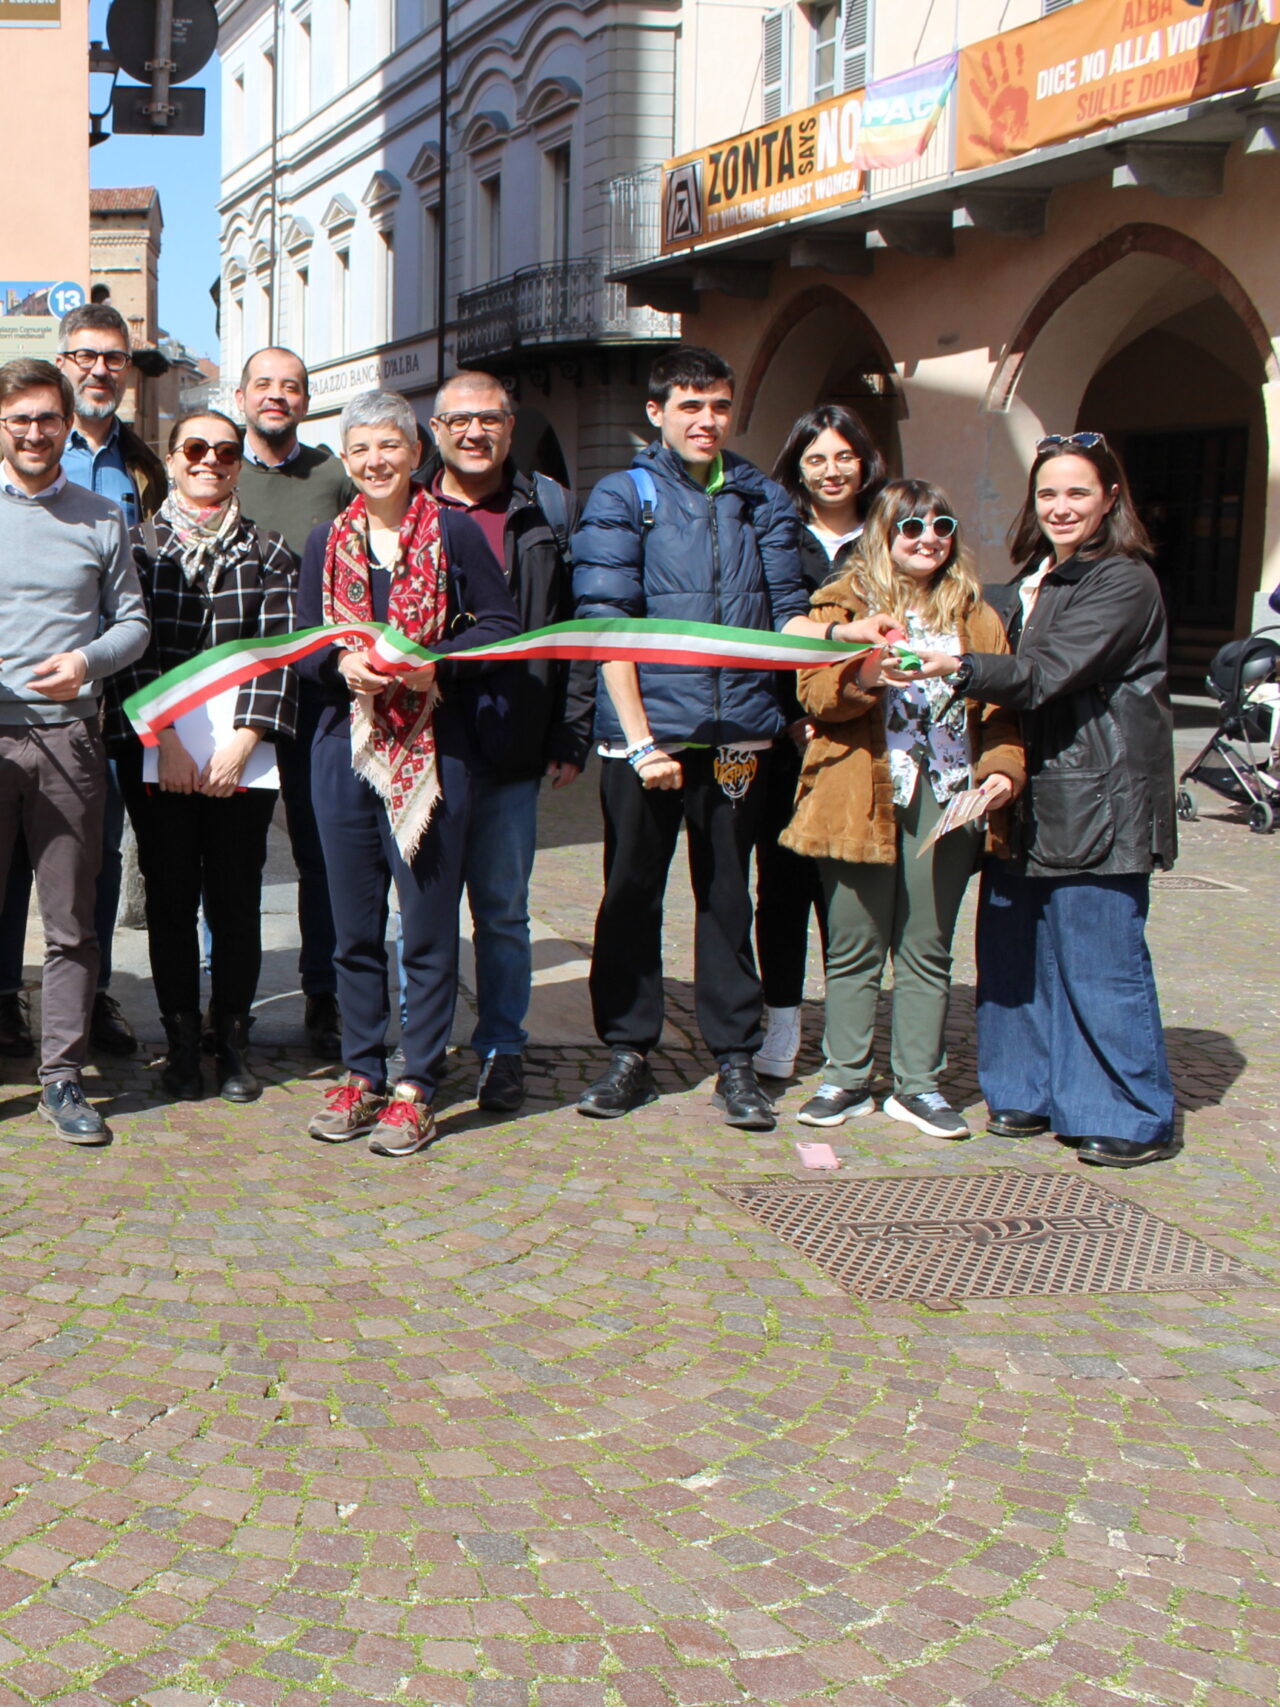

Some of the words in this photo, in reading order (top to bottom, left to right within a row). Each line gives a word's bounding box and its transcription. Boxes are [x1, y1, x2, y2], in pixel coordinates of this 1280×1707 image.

[1119, 0, 1173, 32] ALBA
[1036, 58, 1076, 100] DICE
[1079, 48, 1107, 85] NO
[1109, 29, 1162, 75] ALLA
[1076, 78, 1133, 122] SULLE
[1137, 54, 1210, 104] DONNE
[708, 125, 795, 206] ZONTA
[798, 117, 817, 176] SAYS
[817, 99, 862, 171] NO
[707, 212, 719, 233] TO
[721, 196, 766, 229] VIOLENCE
[767, 182, 812, 215] AGAINST
[815, 168, 860, 200] WOMEN
[55, 290, 81, 312] 13
[309, 371, 348, 396] PALAZZO
[350, 364, 381, 387] BANCA
[384, 353, 420, 379] D'ALBA
